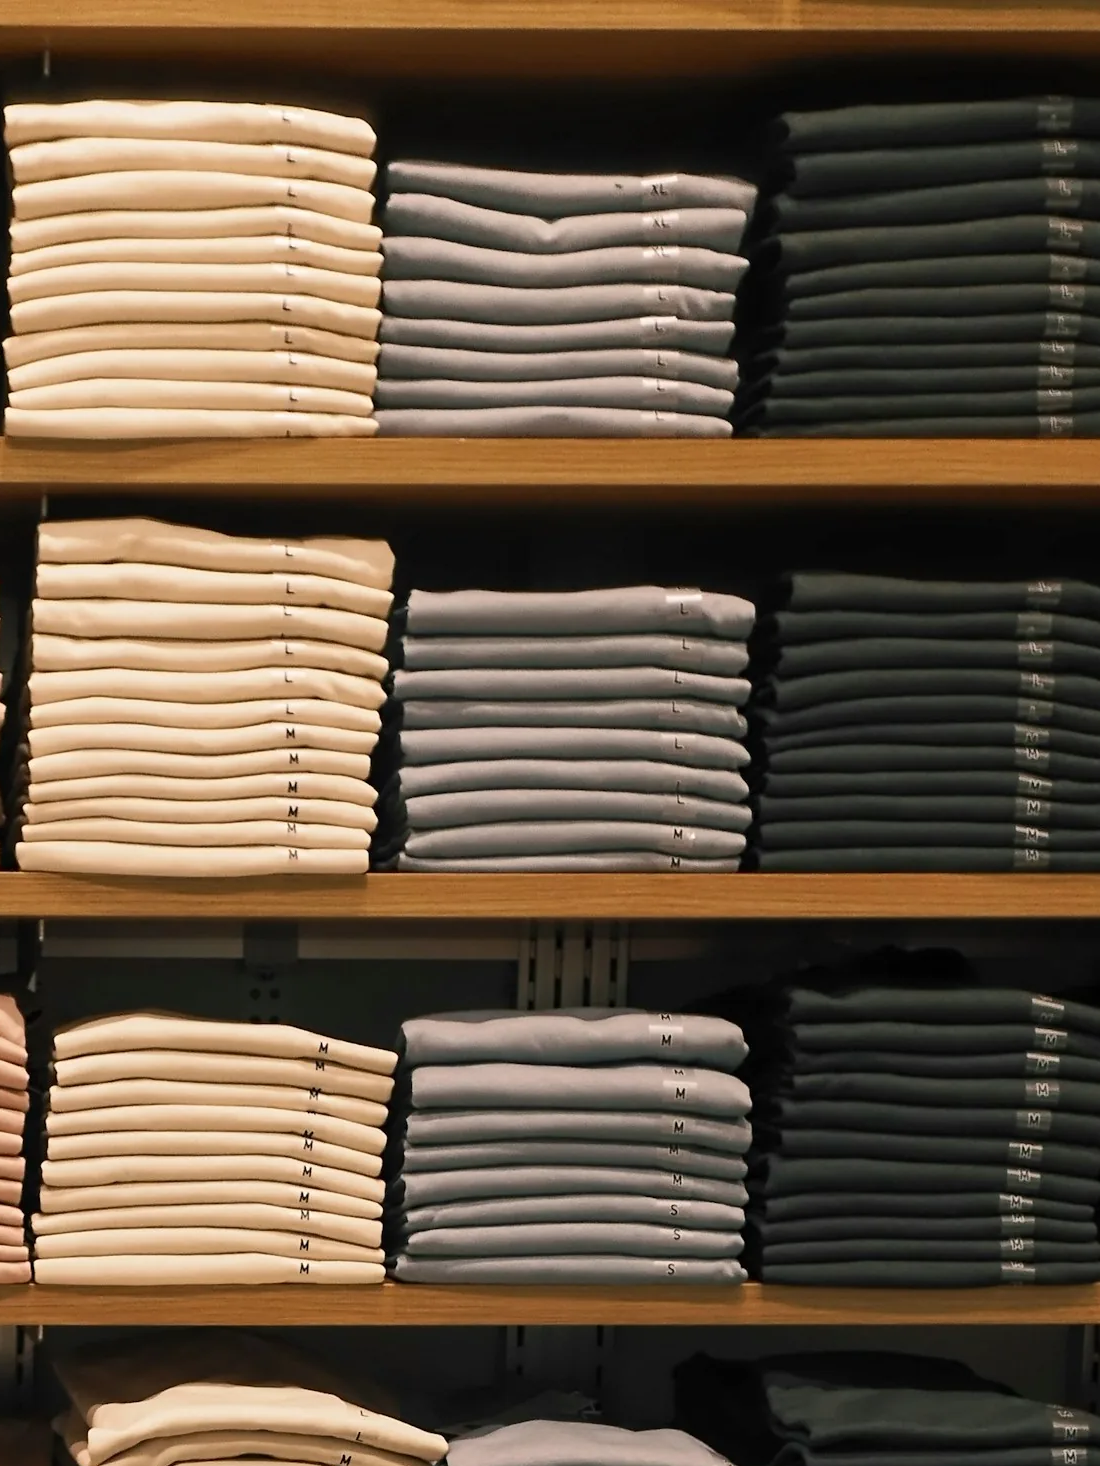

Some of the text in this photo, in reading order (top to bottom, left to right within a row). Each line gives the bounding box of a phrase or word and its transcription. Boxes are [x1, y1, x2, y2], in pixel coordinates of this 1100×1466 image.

[286, 728, 296, 739] M
[289, 753, 299, 764] M
[287, 781, 298, 793] M
[287, 805, 298, 817] M
[672, 828, 683, 840] M
[671, 857, 681, 868] M
[661, 1034, 672, 1046] M
[318, 1042, 329, 1054] M
[675, 1088, 686, 1100] M
[1029, 1114, 1040, 1127] M
[673, 1121, 685, 1133] M
[1020, 1146, 1032, 1159] M
[302, 1166, 312, 1177] M
[670, 1204, 679, 1216] S
[299, 1238, 310, 1251] M
[299, 1263, 310, 1275] M
[667, 1263, 676, 1275] S
[340, 1454, 351, 1466] M
[1064, 1449, 1077, 1464] M
